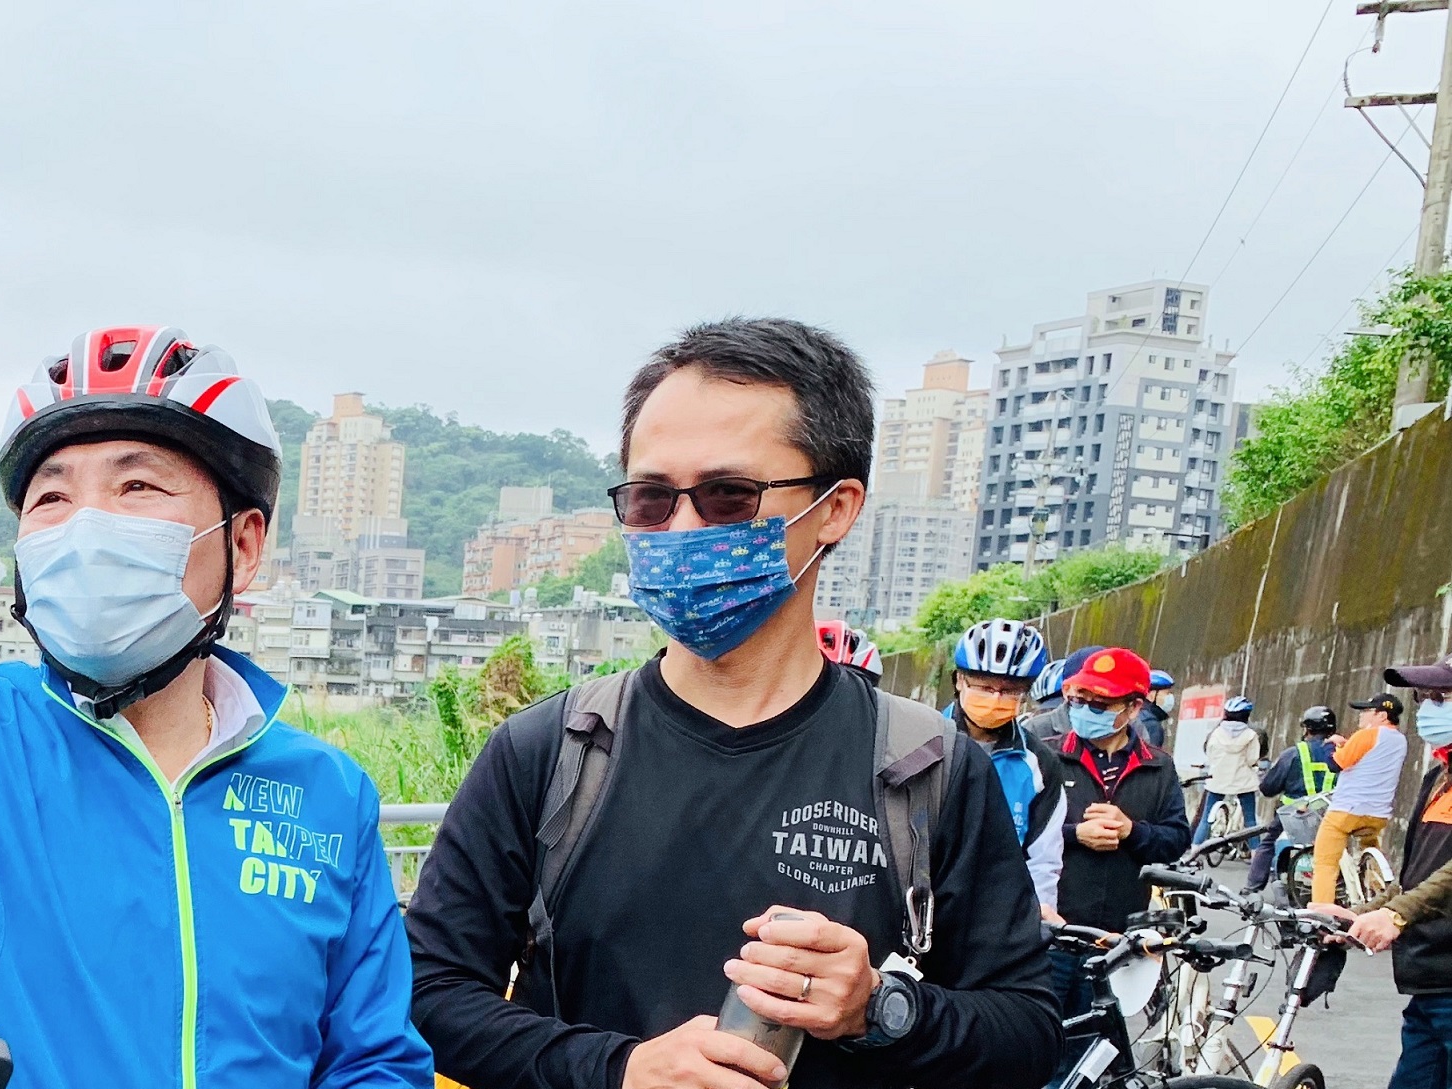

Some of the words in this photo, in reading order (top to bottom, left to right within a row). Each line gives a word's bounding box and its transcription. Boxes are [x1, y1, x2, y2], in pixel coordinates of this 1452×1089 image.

[223, 772, 304, 819] NEW
[229, 817, 343, 869] TAIPEI
[812, 822, 855, 836] DOWNHILL
[772, 830, 888, 869] TAIWAN
[809, 861, 854, 875] CHAPTER
[239, 856, 323, 904] CITY
[777, 861, 826, 894] GLOBAL
[827, 873, 877, 894] ALLIANCE
